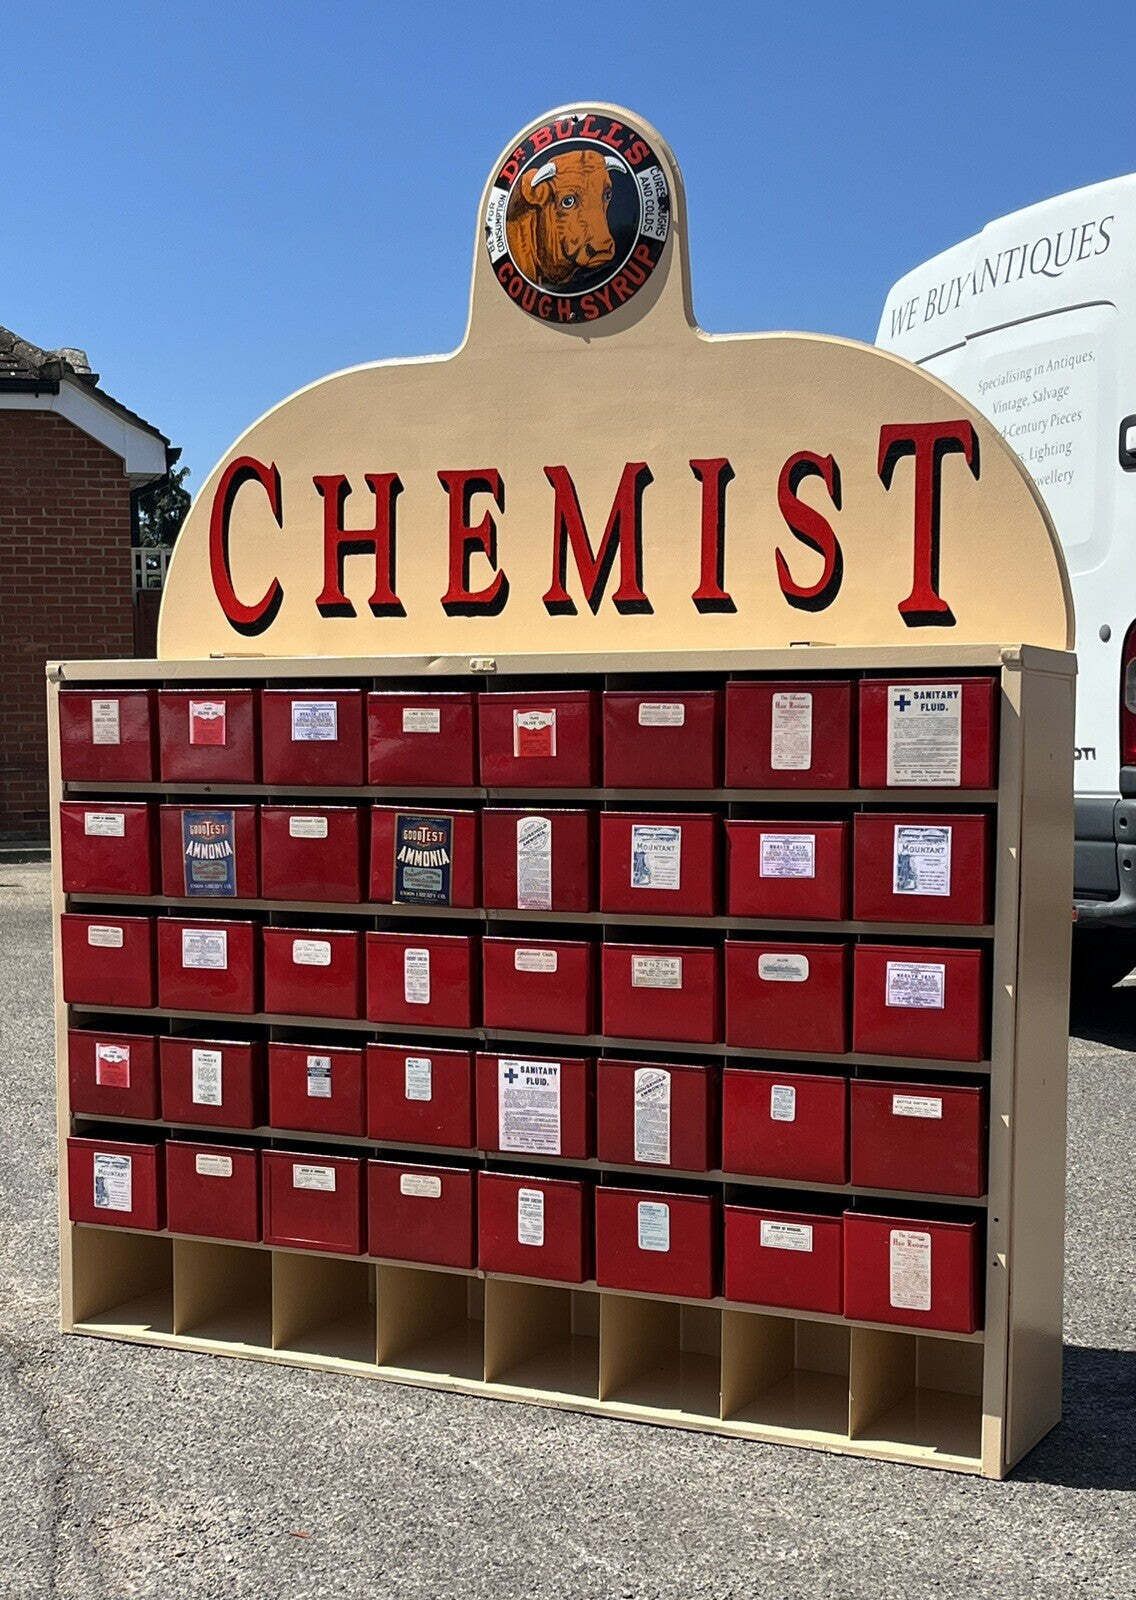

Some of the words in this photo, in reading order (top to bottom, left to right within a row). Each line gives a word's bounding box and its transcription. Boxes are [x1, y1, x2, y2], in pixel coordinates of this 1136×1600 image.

[529, 115, 650, 166] BULL'S
[640, 176, 652, 198] AND
[650, 167, 667, 199] CURES
[487, 201, 496, 222] FOR
[495, 194, 506, 254] CONSUMPTION
[497, 262, 575, 321] COUGH
[580, 243, 656, 321] SYRUP
[891, 297, 920, 338] WE
[924, 272, 971, 323] BUY
[978, 367, 1033, 396] Specialising
[1034, 363, 1045, 377] in
[1032, 384, 1071, 403] Salvage
[1000, 418, 1049, 438] d-Century
[1050, 410, 1082, 428] Pieces
[1029, 441, 1073, 463] Lighting
[1034, 468, 1075, 489] wellery
[209, 420, 980, 637] CHEMIST
[913, 690, 959, 700] SANITARY
[920, 702, 949, 712] FLUID.
[185, 840, 233, 860] AMMONIA
[397, 845, 450, 867] AMMONIA
[520, 1065, 558, 1076] SANITARY
